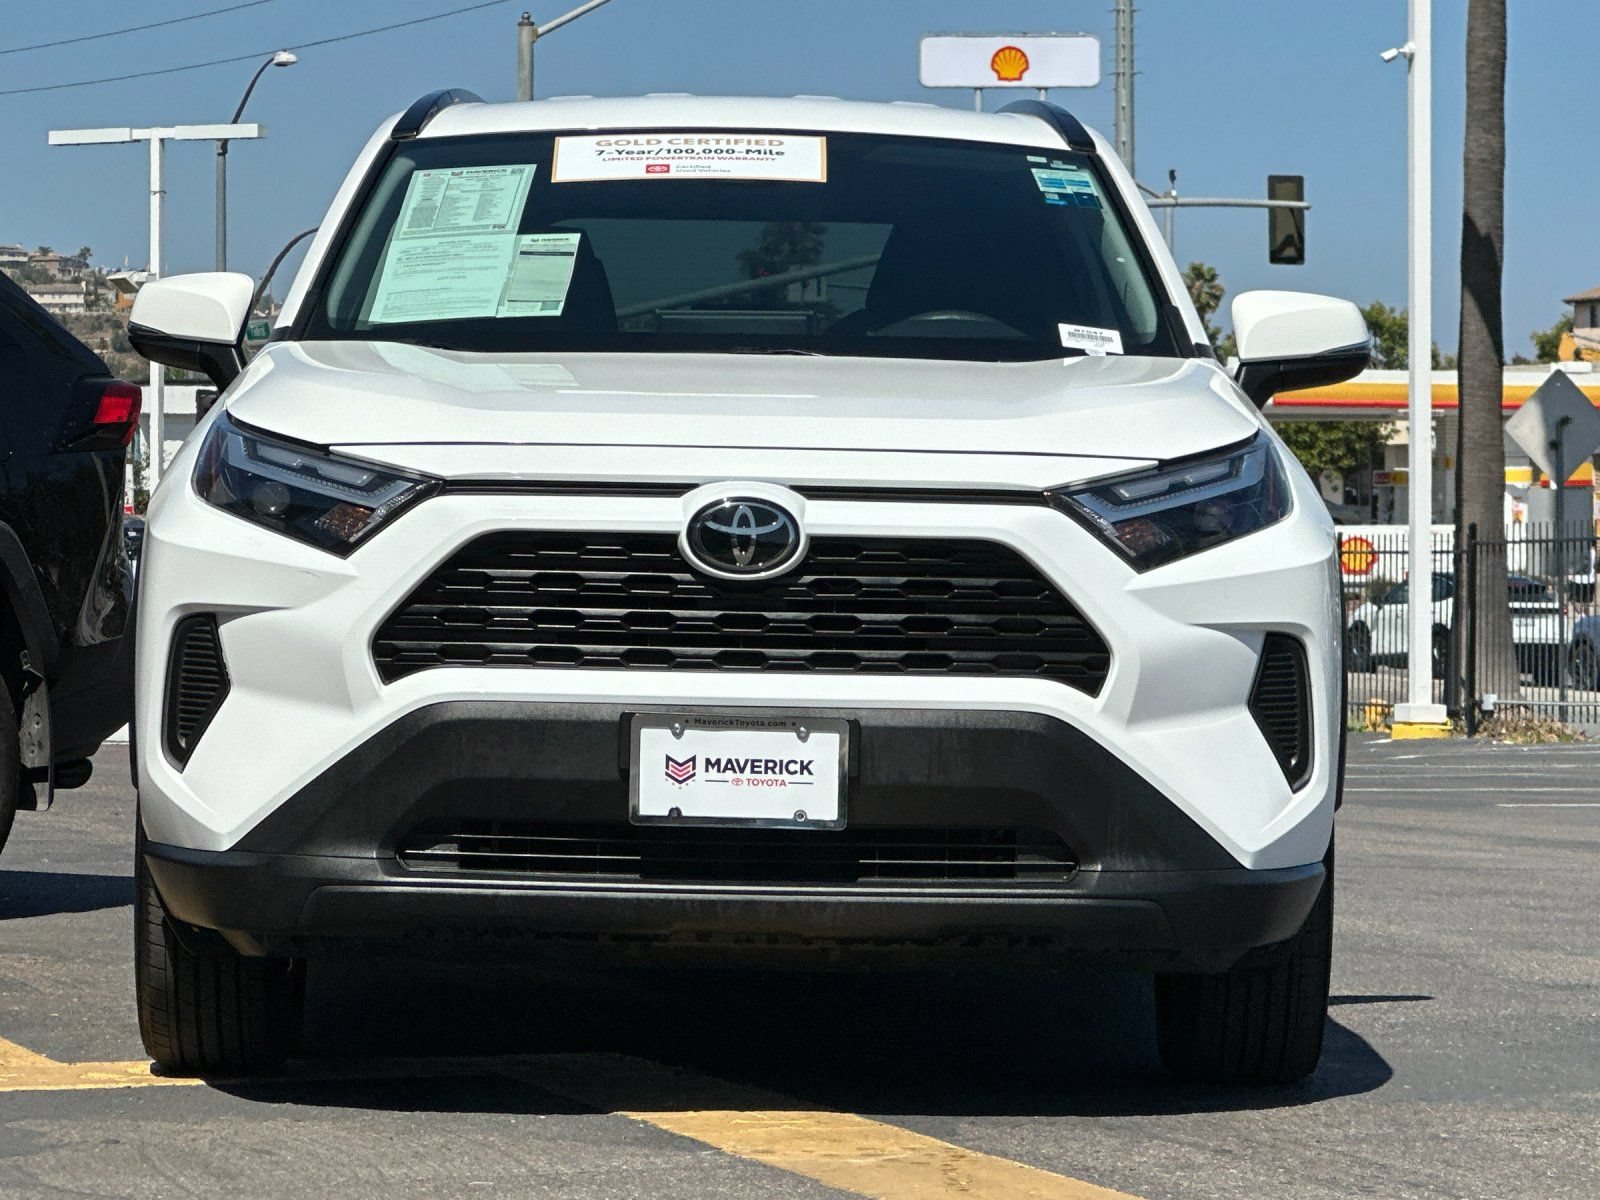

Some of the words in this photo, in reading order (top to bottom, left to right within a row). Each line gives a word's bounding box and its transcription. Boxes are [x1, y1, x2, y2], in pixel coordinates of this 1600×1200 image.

[667, 138, 784, 146] CERTIFIED
[595, 148, 785, 156] 7-Year/100,000-Mile
[694, 718, 786, 727] MaverickToyota.com
[705, 757, 814, 775] MAVERICK
[745, 777, 787, 788] TOYOTA
